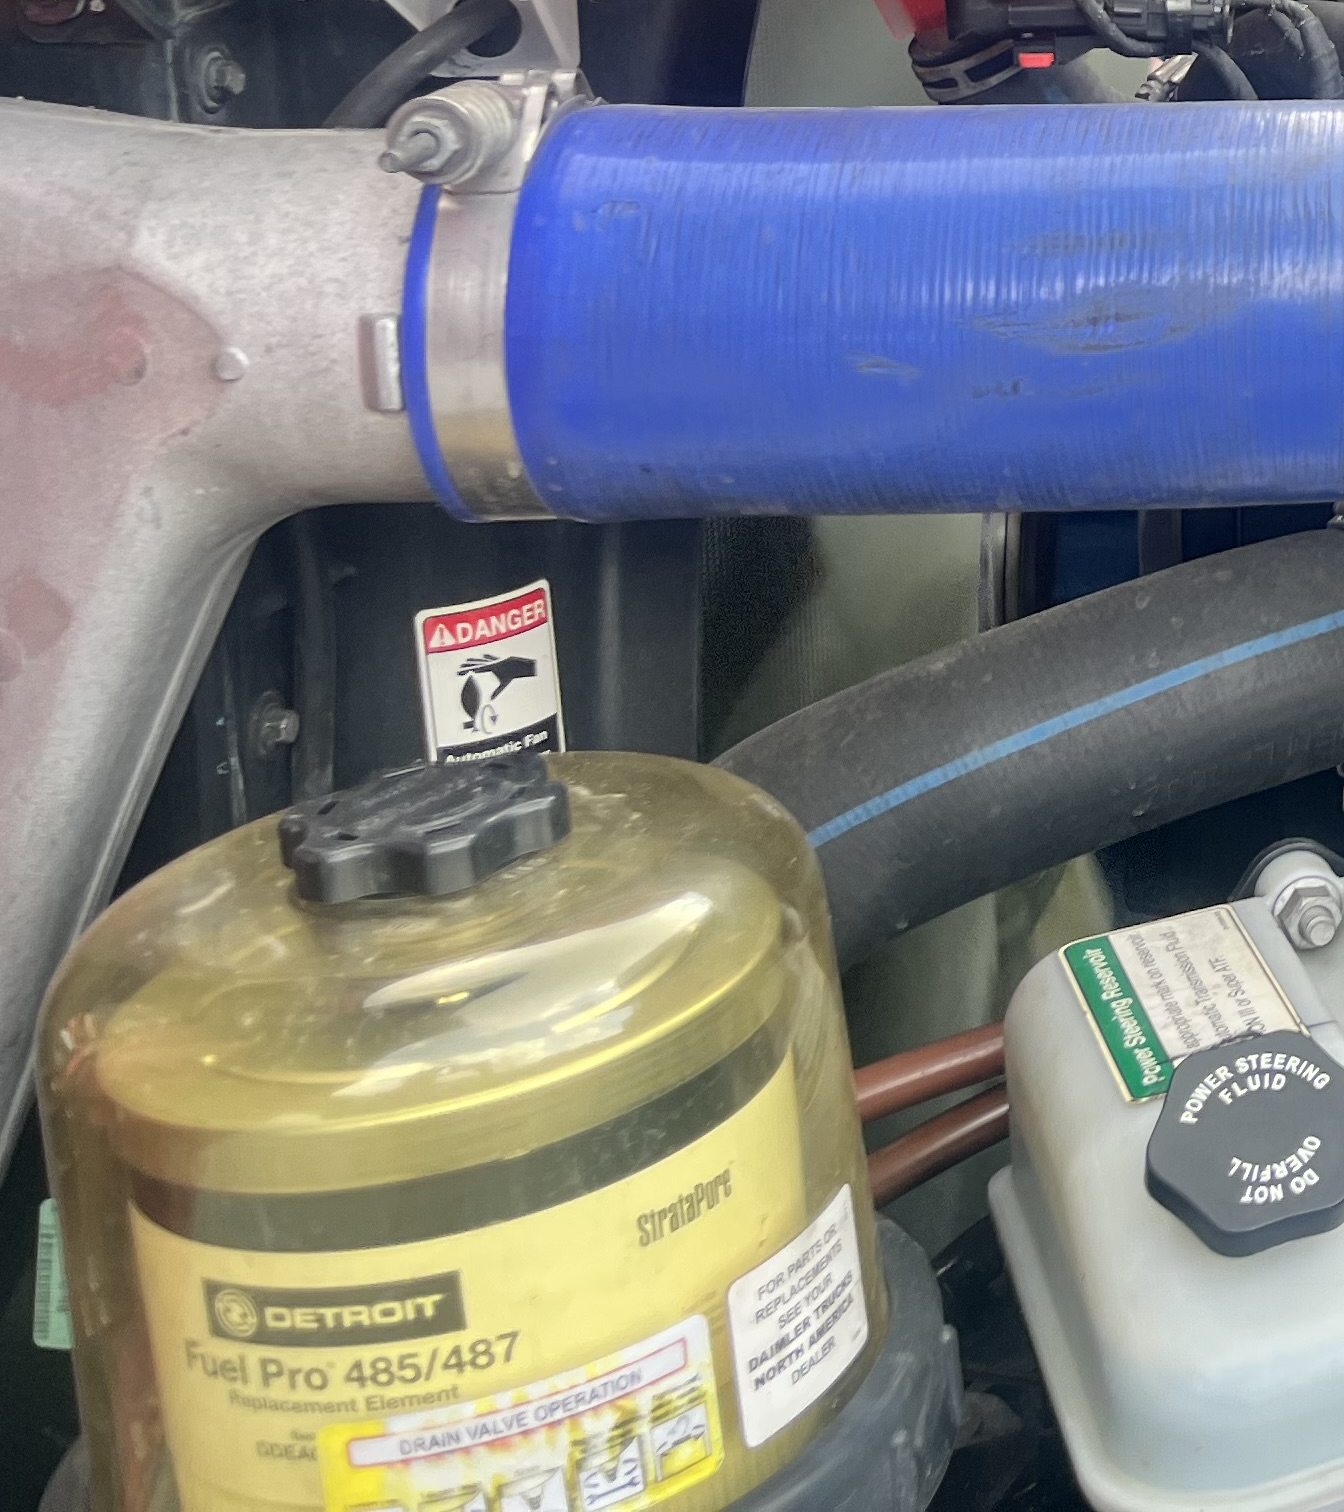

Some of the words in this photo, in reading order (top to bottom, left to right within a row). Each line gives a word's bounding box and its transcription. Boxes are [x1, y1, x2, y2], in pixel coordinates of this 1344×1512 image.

[455, 599, 546, 644] DANGER
[445, 740, 522, 764] Automatic
[522, 729, 548, 749] Fan
[1085, 948, 1122, 1001] Reservoir
[1149, 967, 1160, 980] on
[1153, 980, 1171, 1003] mark
[1174, 951, 1210, 1006] Transmission
[1222, 973, 1245, 999] Super
[1111, 997, 1146, 1050] Steering
[1164, 1000, 1200, 1049] appropriate
[1134, 1048, 1165, 1086] Power
[1179, 1064, 1234, 1125] POWER
[1235, 1052, 1331, 1091] STEERING
[1217, 1072, 1287, 1106] FLUID
[1227, 1135, 1322, 1183] OVERFILL
[1290, 1167, 1320, 1196] DO
[636, 1167, 732, 1248] StrataPore
[1239, 1183, 1284, 1205] NOT
[755, 1238, 843, 1325] REPLACEMENTS
[757, 1272, 784, 1301] FOR
[788, 1241, 823, 1276] PARTS
[823, 1223, 838, 1246] OR
[264, 1292, 448, 1330] DETROIT
[748, 1318, 812, 1374] DAIMLER
[814, 1270, 853, 1320] TRUCKS
[778, 1305, 802, 1330] SEE
[805, 1272, 833, 1306] YOUR
[185, 1341, 249, 1387] Fuel
[344, 1329, 522, 1388] 485/487
[754, 1344, 805, 1392] NORTH
[808, 1292, 854, 1349] AMERICA
[791, 1335, 836, 1386] DEALER
[229, 1389, 358, 1414] Replacement
[365, 1384, 460, 1412] Element
[399, 1429, 461, 1457] DRAIN
[466, 1410, 529, 1440] VALVE
[533, 1366, 643, 1423] OPERATION
